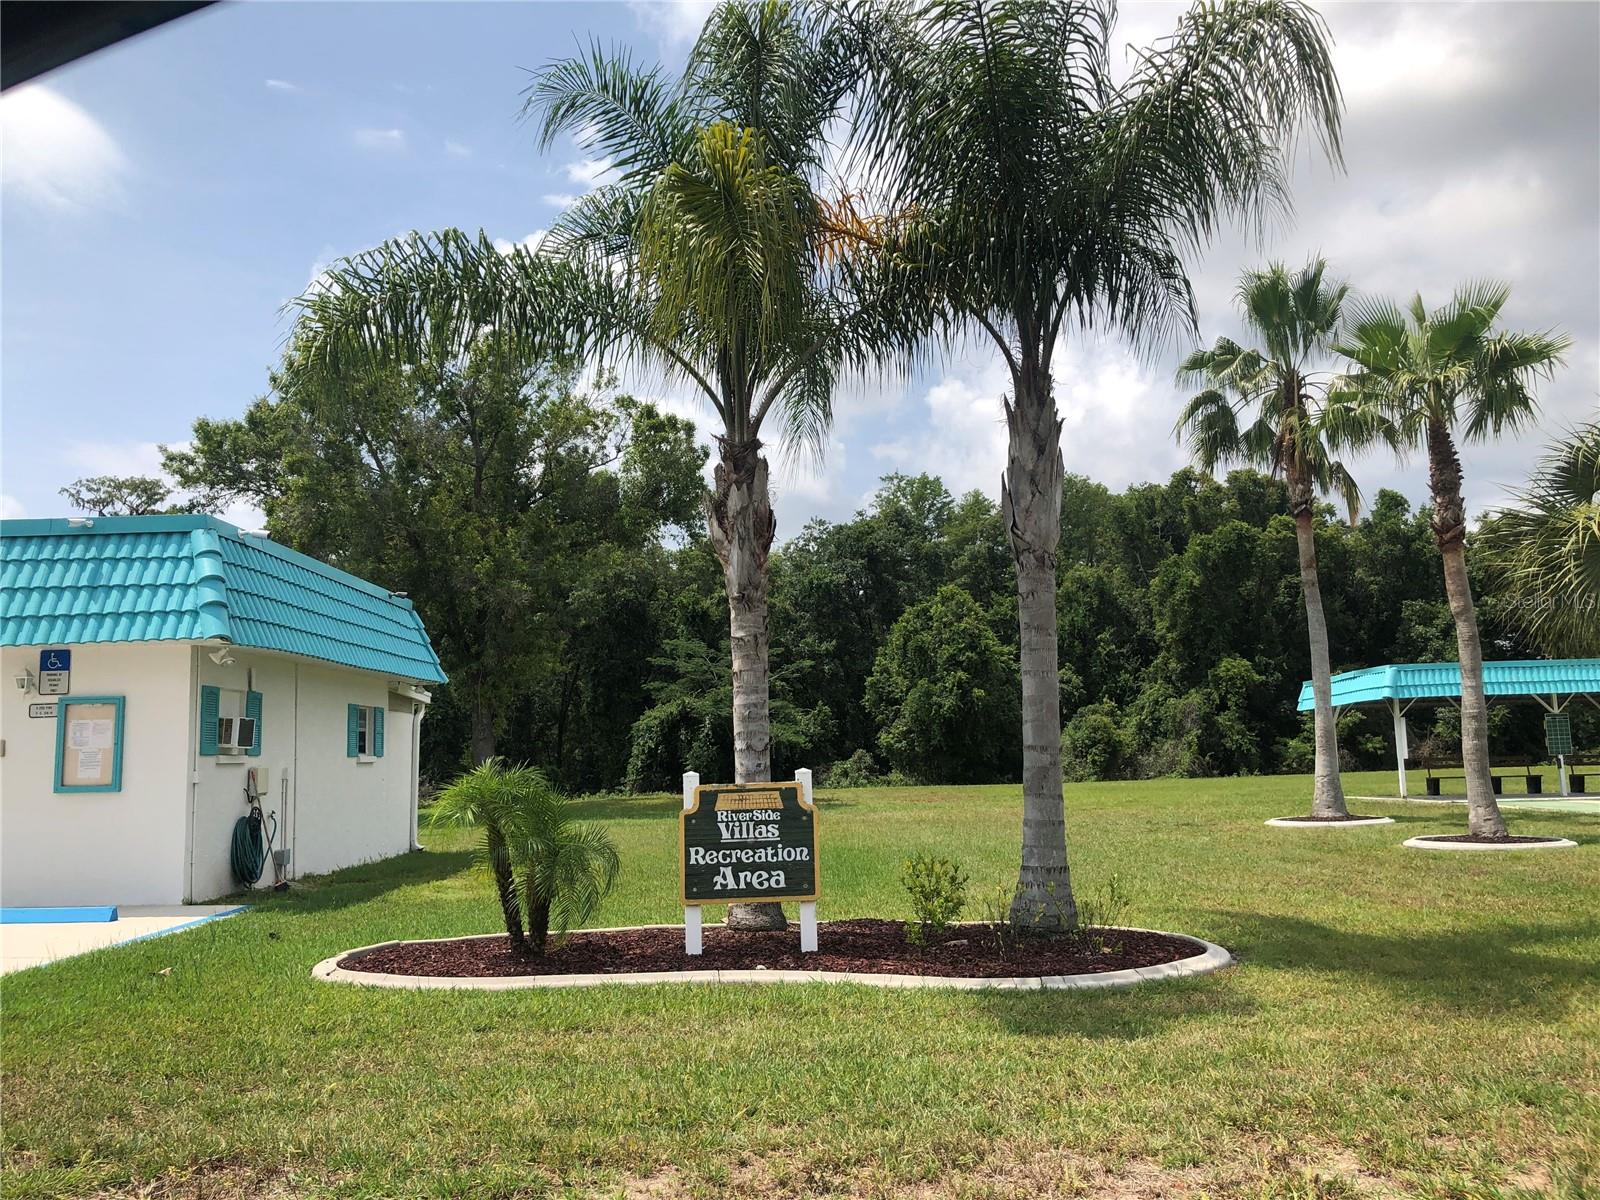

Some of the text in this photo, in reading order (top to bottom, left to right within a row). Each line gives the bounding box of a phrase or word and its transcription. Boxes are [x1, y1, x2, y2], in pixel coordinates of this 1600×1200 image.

[717, 821, 780, 839] Villas
[689, 844, 810, 865] Recreation
[713, 866, 787, 890] Area
